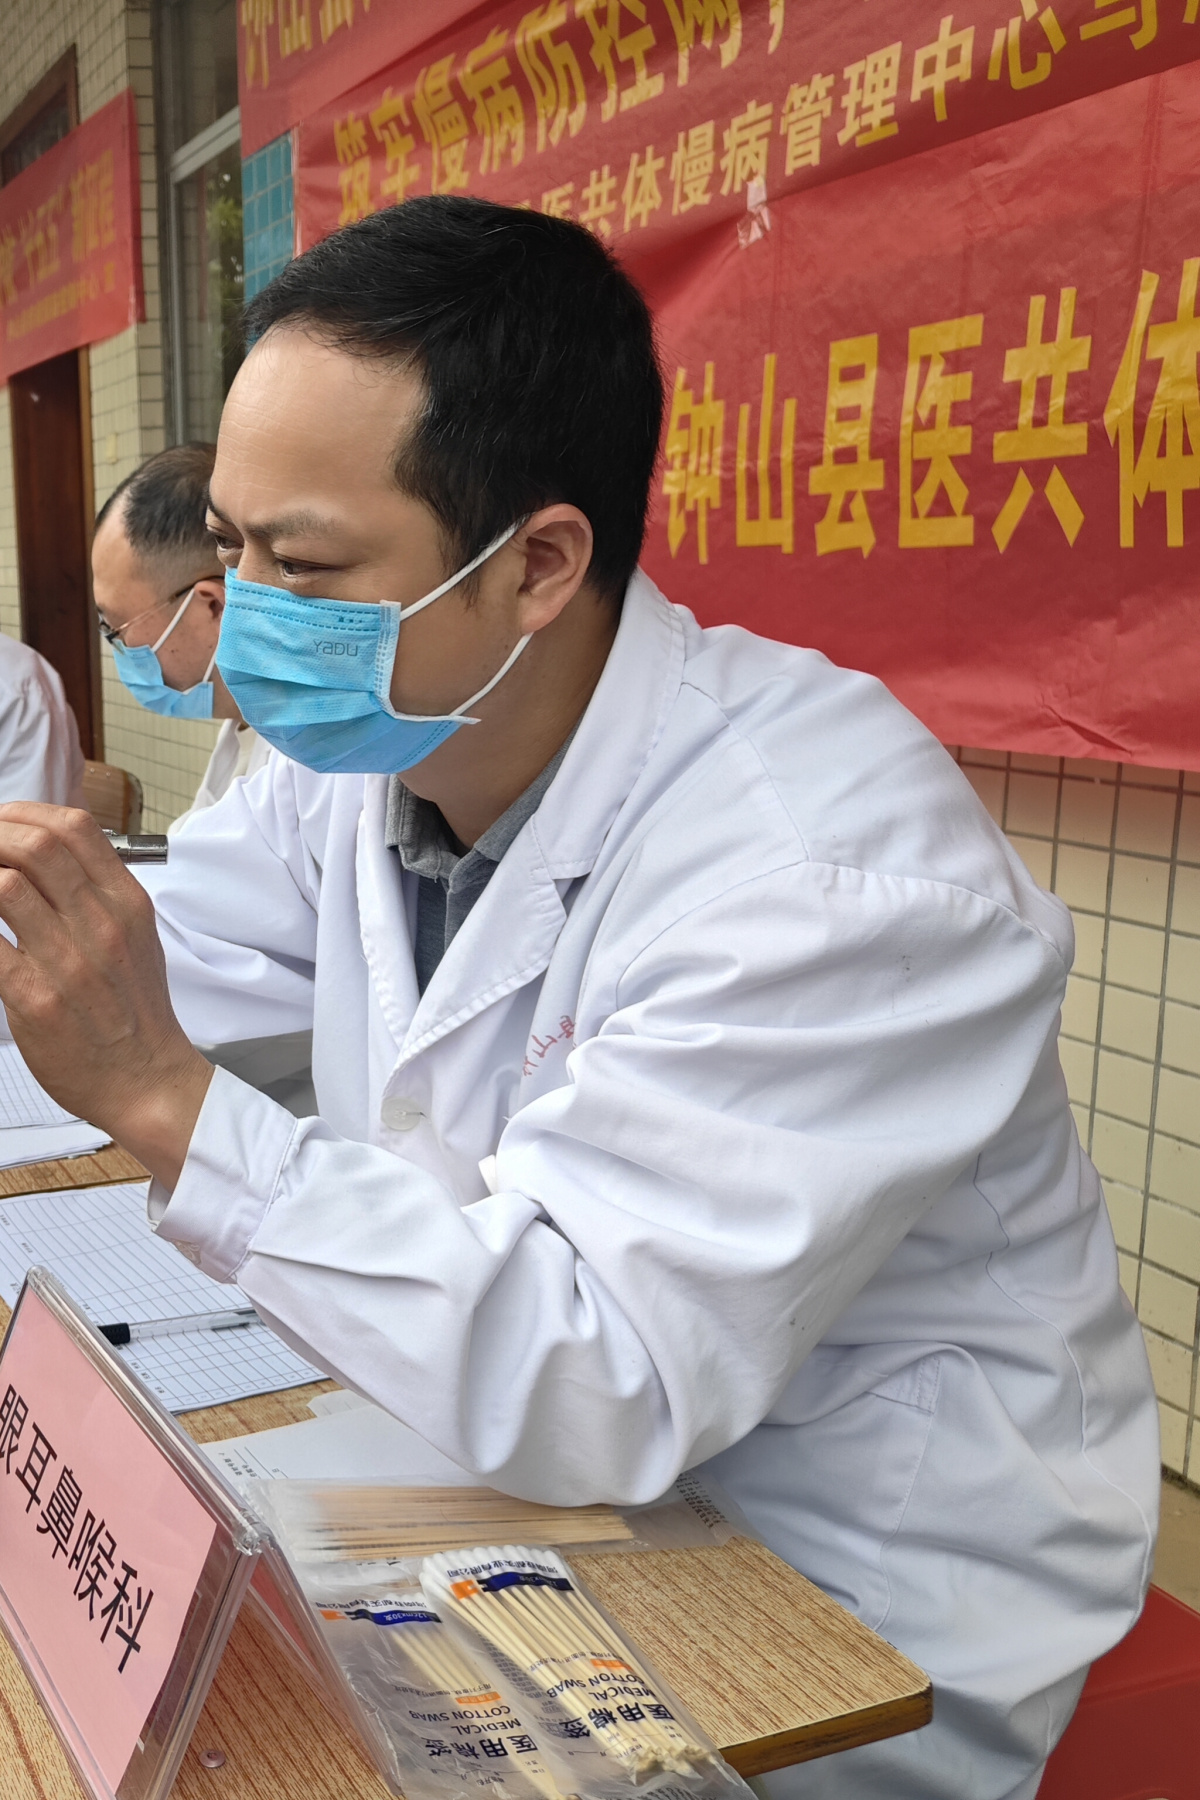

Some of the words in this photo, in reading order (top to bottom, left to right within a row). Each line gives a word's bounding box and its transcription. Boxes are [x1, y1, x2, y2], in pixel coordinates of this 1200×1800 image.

[661, 256, 1200, 566] 钟山县医共体
[546, 1678, 585, 1698] SWAB
[586, 1670, 646, 1688] COTTON
[588, 1683, 656, 1701] MEDICAL
[408, 1710, 448, 1723] SWAB
[451, 1705, 511, 1720] COTTON
[558, 1701, 676, 1740] 医用棉签
[450, 1717, 521, 1736] MEDICAL
[420, 1734, 538, 1760] 医用棉签
